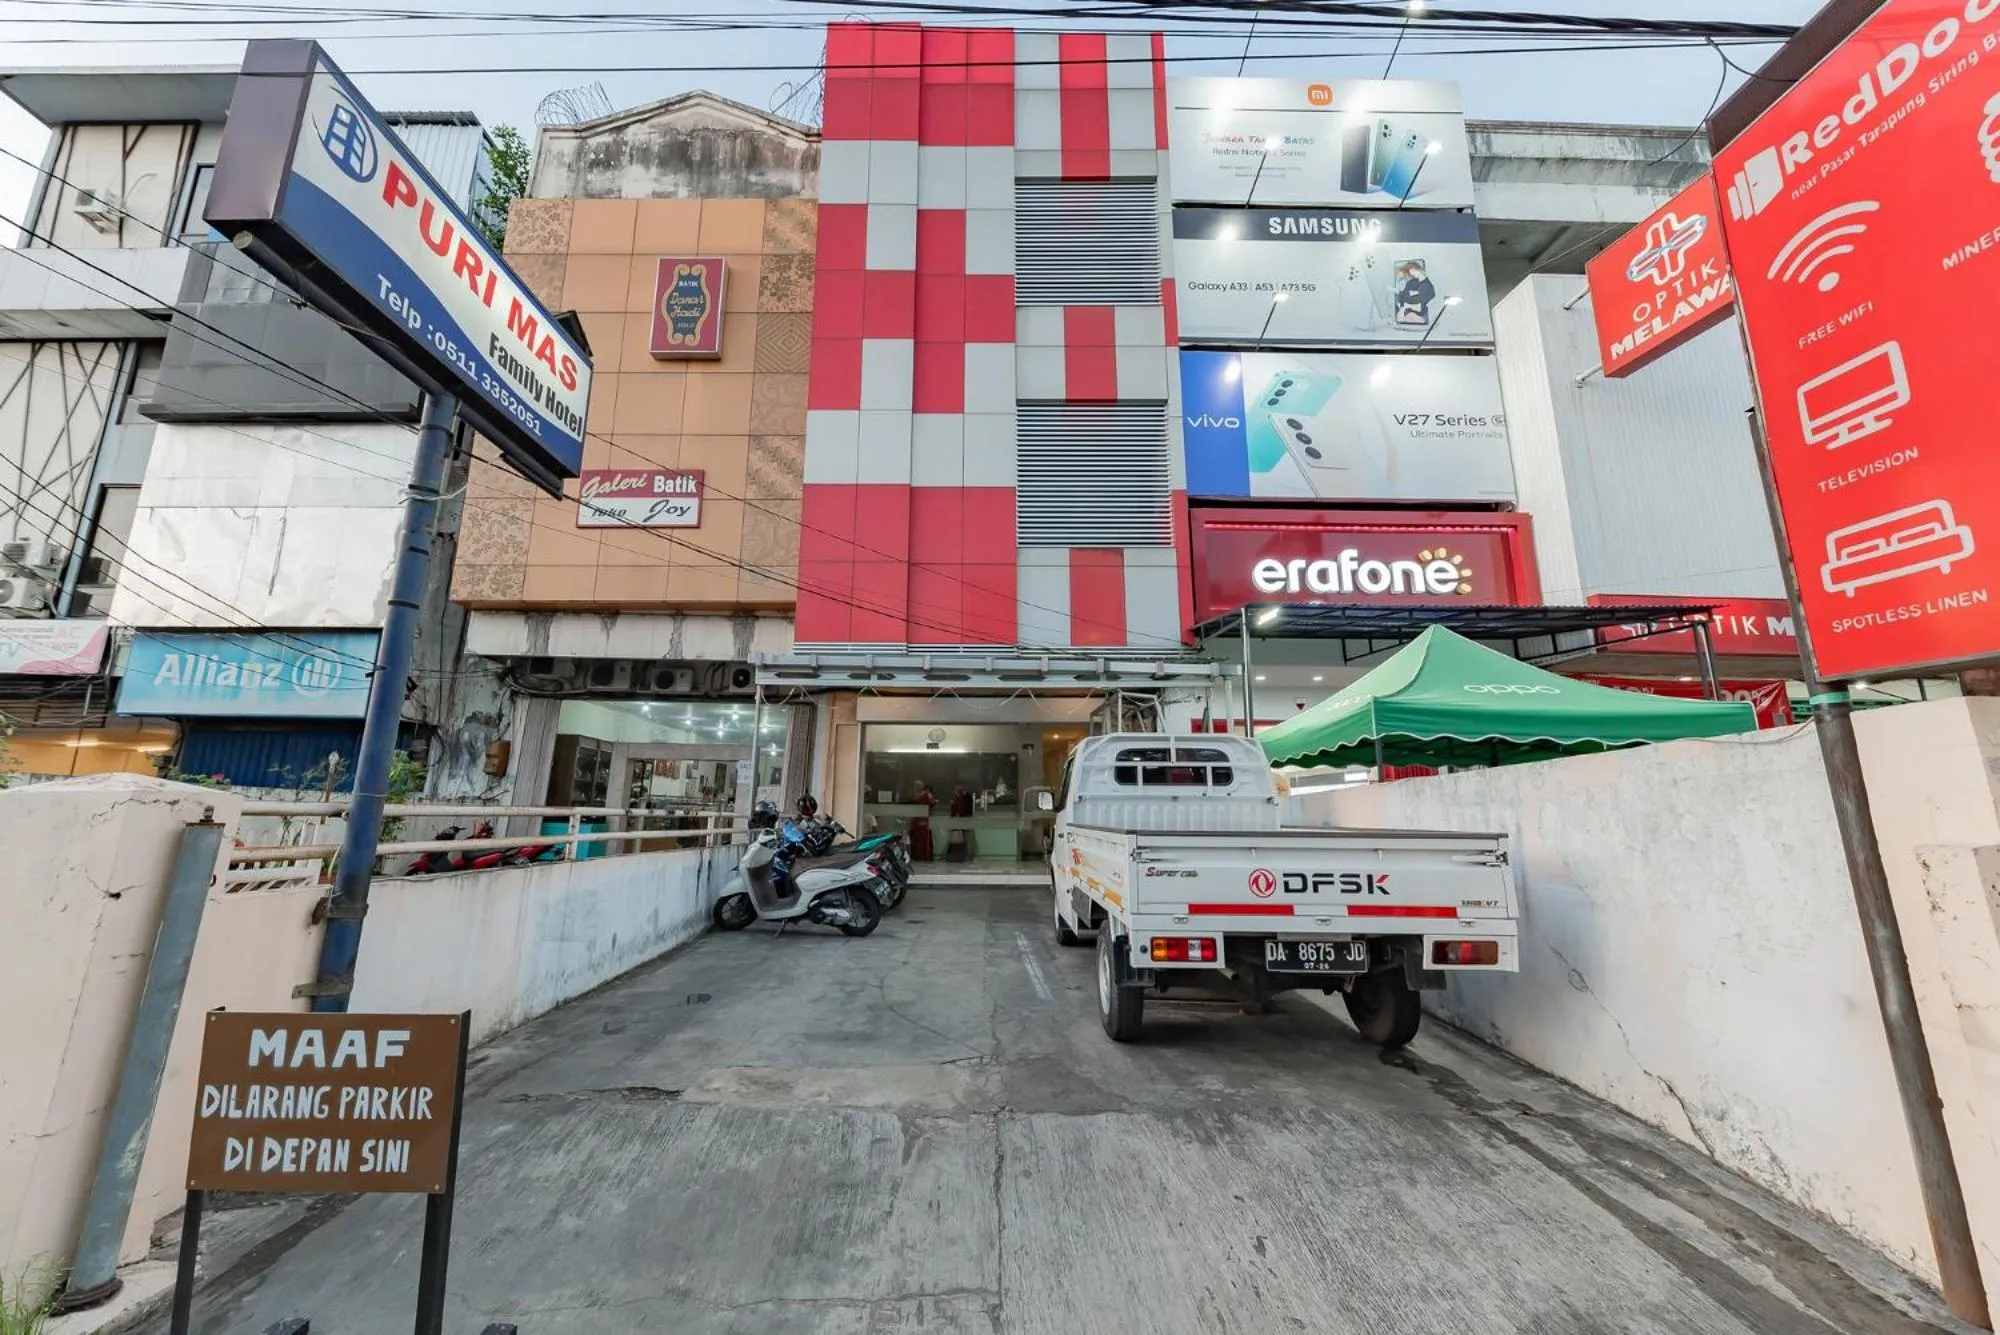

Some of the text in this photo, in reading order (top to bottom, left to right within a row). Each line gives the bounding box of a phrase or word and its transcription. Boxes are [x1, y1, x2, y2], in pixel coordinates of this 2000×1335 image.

[1791, 174, 1818, 200] near
[1820, 146, 1856, 178] Pasar
[1858, 92, 1926, 148] Tarapung
[1928, 51, 1979, 94] Siring
[382, 160, 577, 391] PURI MAS
[1188, 281, 1227, 292] Galaxy
[1229, 282, 1248, 290] A33
[1255, 283, 1274, 291] A53
[1281, 283, 1299, 291] A73
[1633, 257, 1718, 322] OPTIK
[1798, 300, 1874, 349] FREE WIFI
[377, 273, 422, 329] Telp
[481, 373, 542, 437] 3352051
[489, 332, 583, 438] Family Hotel
[1187, 414, 1240, 428] vivo
[1393, 414, 1430, 425] V27
[1435, 414, 1487, 426] Series
[1410, 430, 1455, 438] Ultimate
[654, 475, 697, 492] Batik
[1817, 446, 1920, 494] TELEVISION
[643, 499, 692, 522] Joy
[1252, 549, 1460, 594] erafone
[1832, 588, 1988, 634] SPOTLESS LINEN
[154, 653, 285, 688] Allianz
[1464, 684, 1561, 695] oppo
[1283, 872, 1392, 895] DFSK
[1266, 942, 1364, 961] DA 8675 JD
[248, 1028, 411, 1068] MAAF
[201, 1084, 433, 1120] DILARANG PARKIR
[223, 1136, 411, 1173] DI DEPAN SINI
